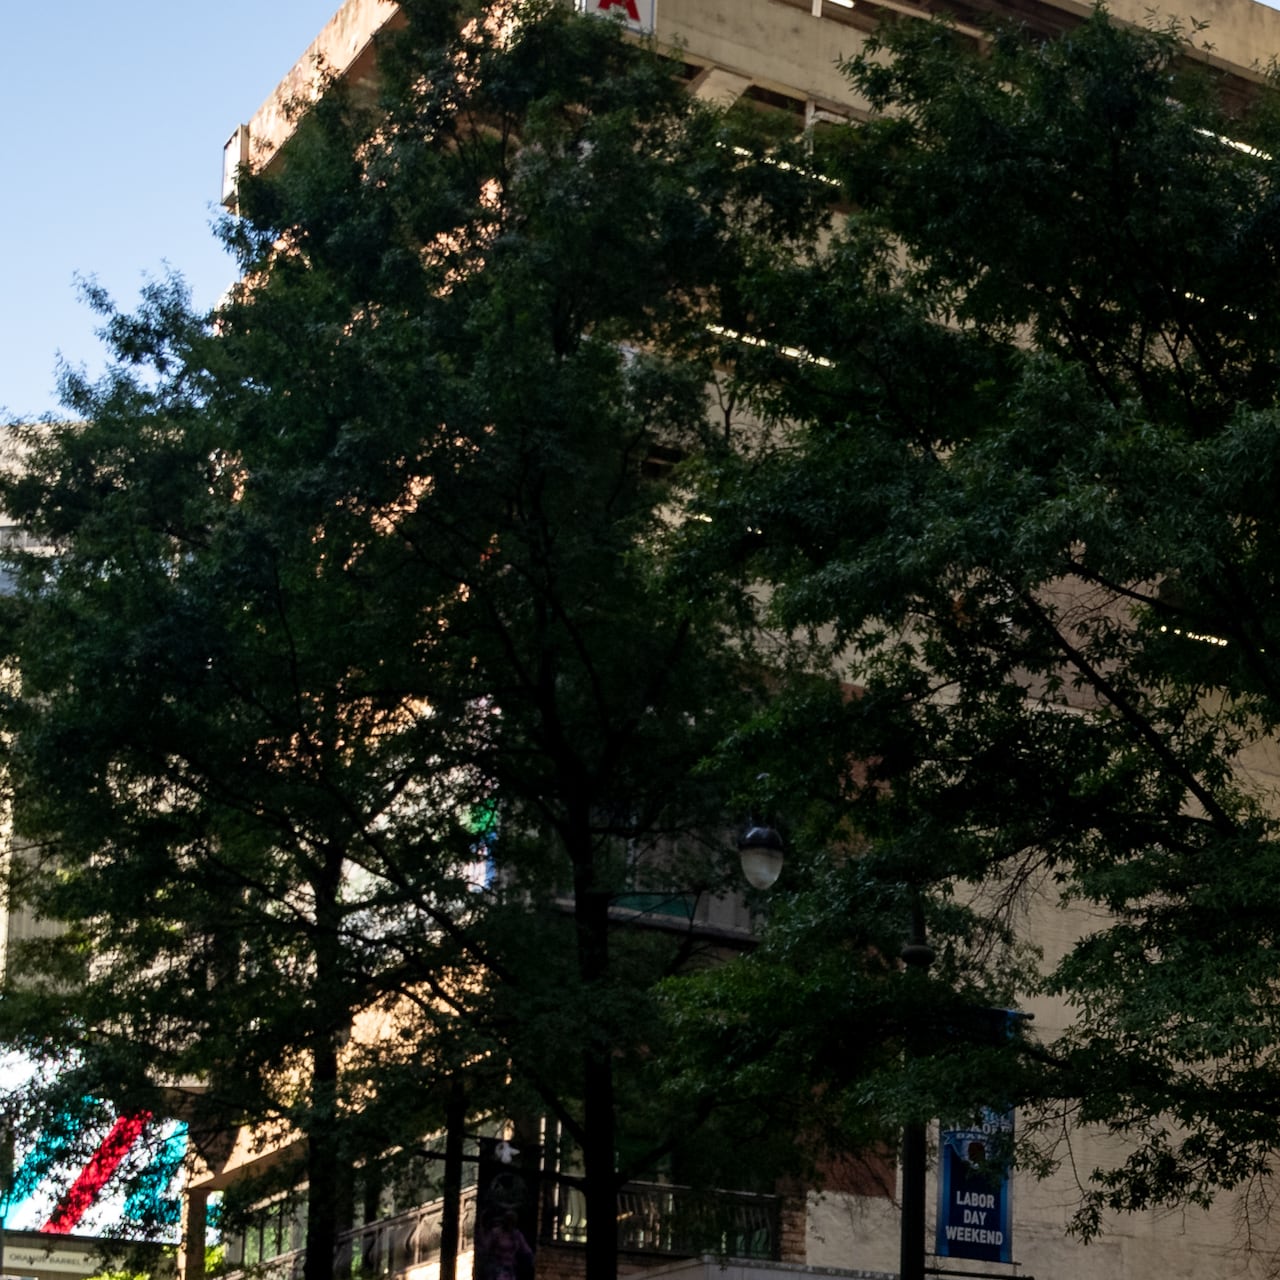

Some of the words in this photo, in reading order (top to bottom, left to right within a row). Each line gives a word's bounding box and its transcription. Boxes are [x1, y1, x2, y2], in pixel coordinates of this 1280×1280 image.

[956, 1190, 995, 1209] LABOR
[963, 1209, 987, 1226] DAY
[945, 1225, 1004, 1246] WEEKEND
